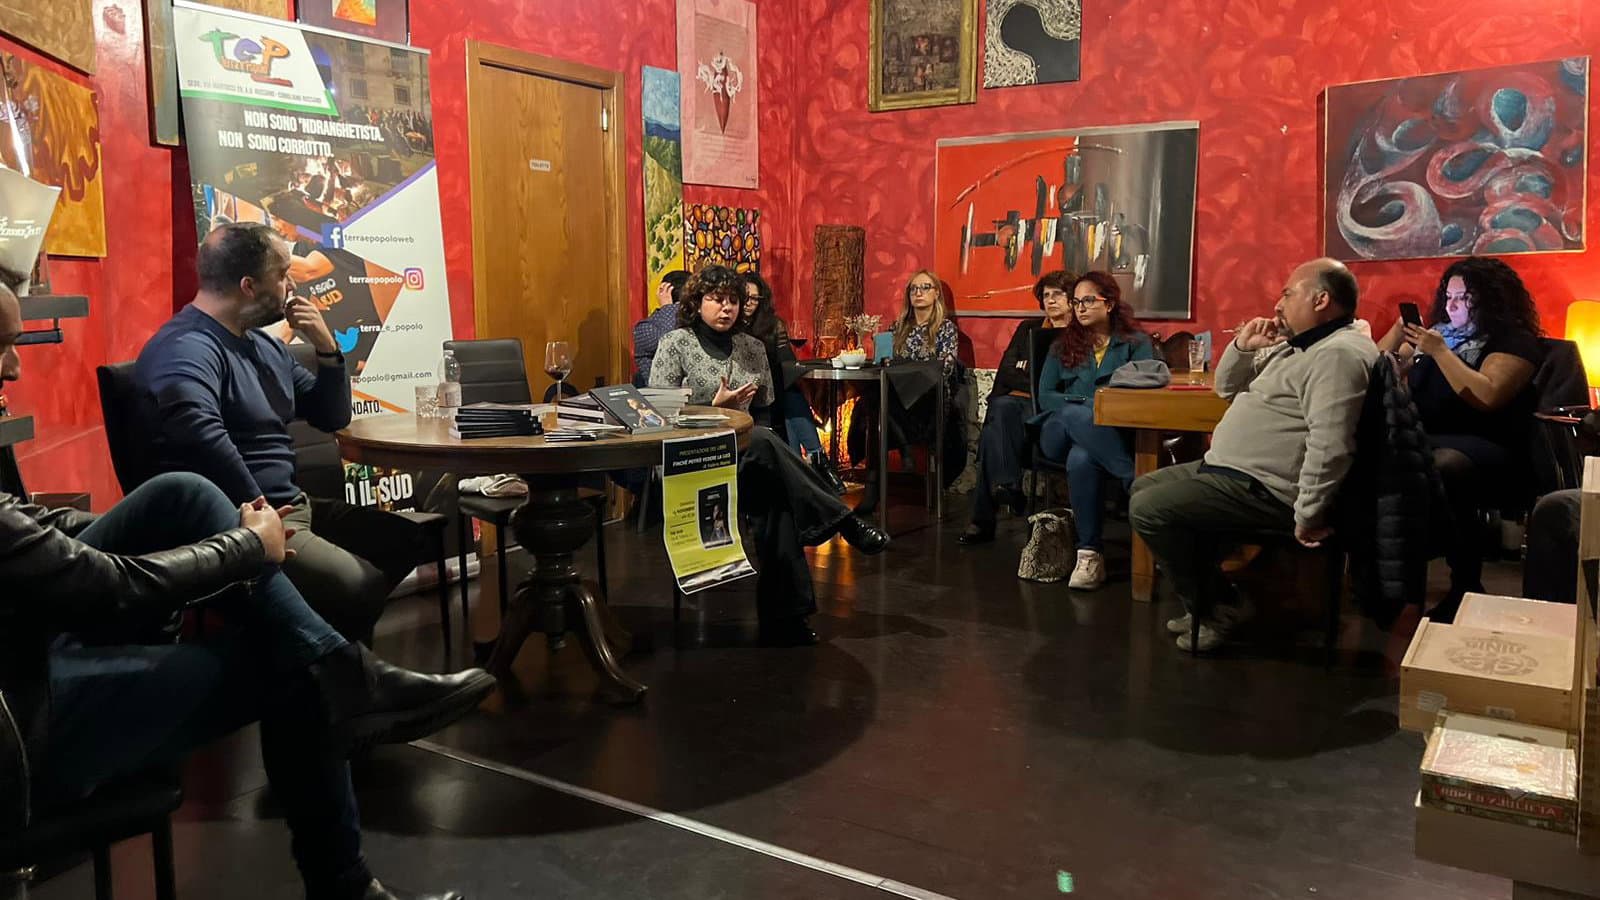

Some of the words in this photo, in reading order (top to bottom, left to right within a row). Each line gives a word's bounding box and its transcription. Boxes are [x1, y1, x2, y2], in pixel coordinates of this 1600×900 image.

[244, 110, 269, 128] NON
[270, 113, 297, 132] SONO
[218, 130, 244, 148] NON
[248, 133, 277, 151] SONO
[278, 137, 335, 158] CORROTTO.
[344, 234, 415, 243] terraepopoloweb
[349, 275, 404, 284] terraepopolo
[359, 480, 377, 507] IL
[379, 473, 413, 503] SUD
